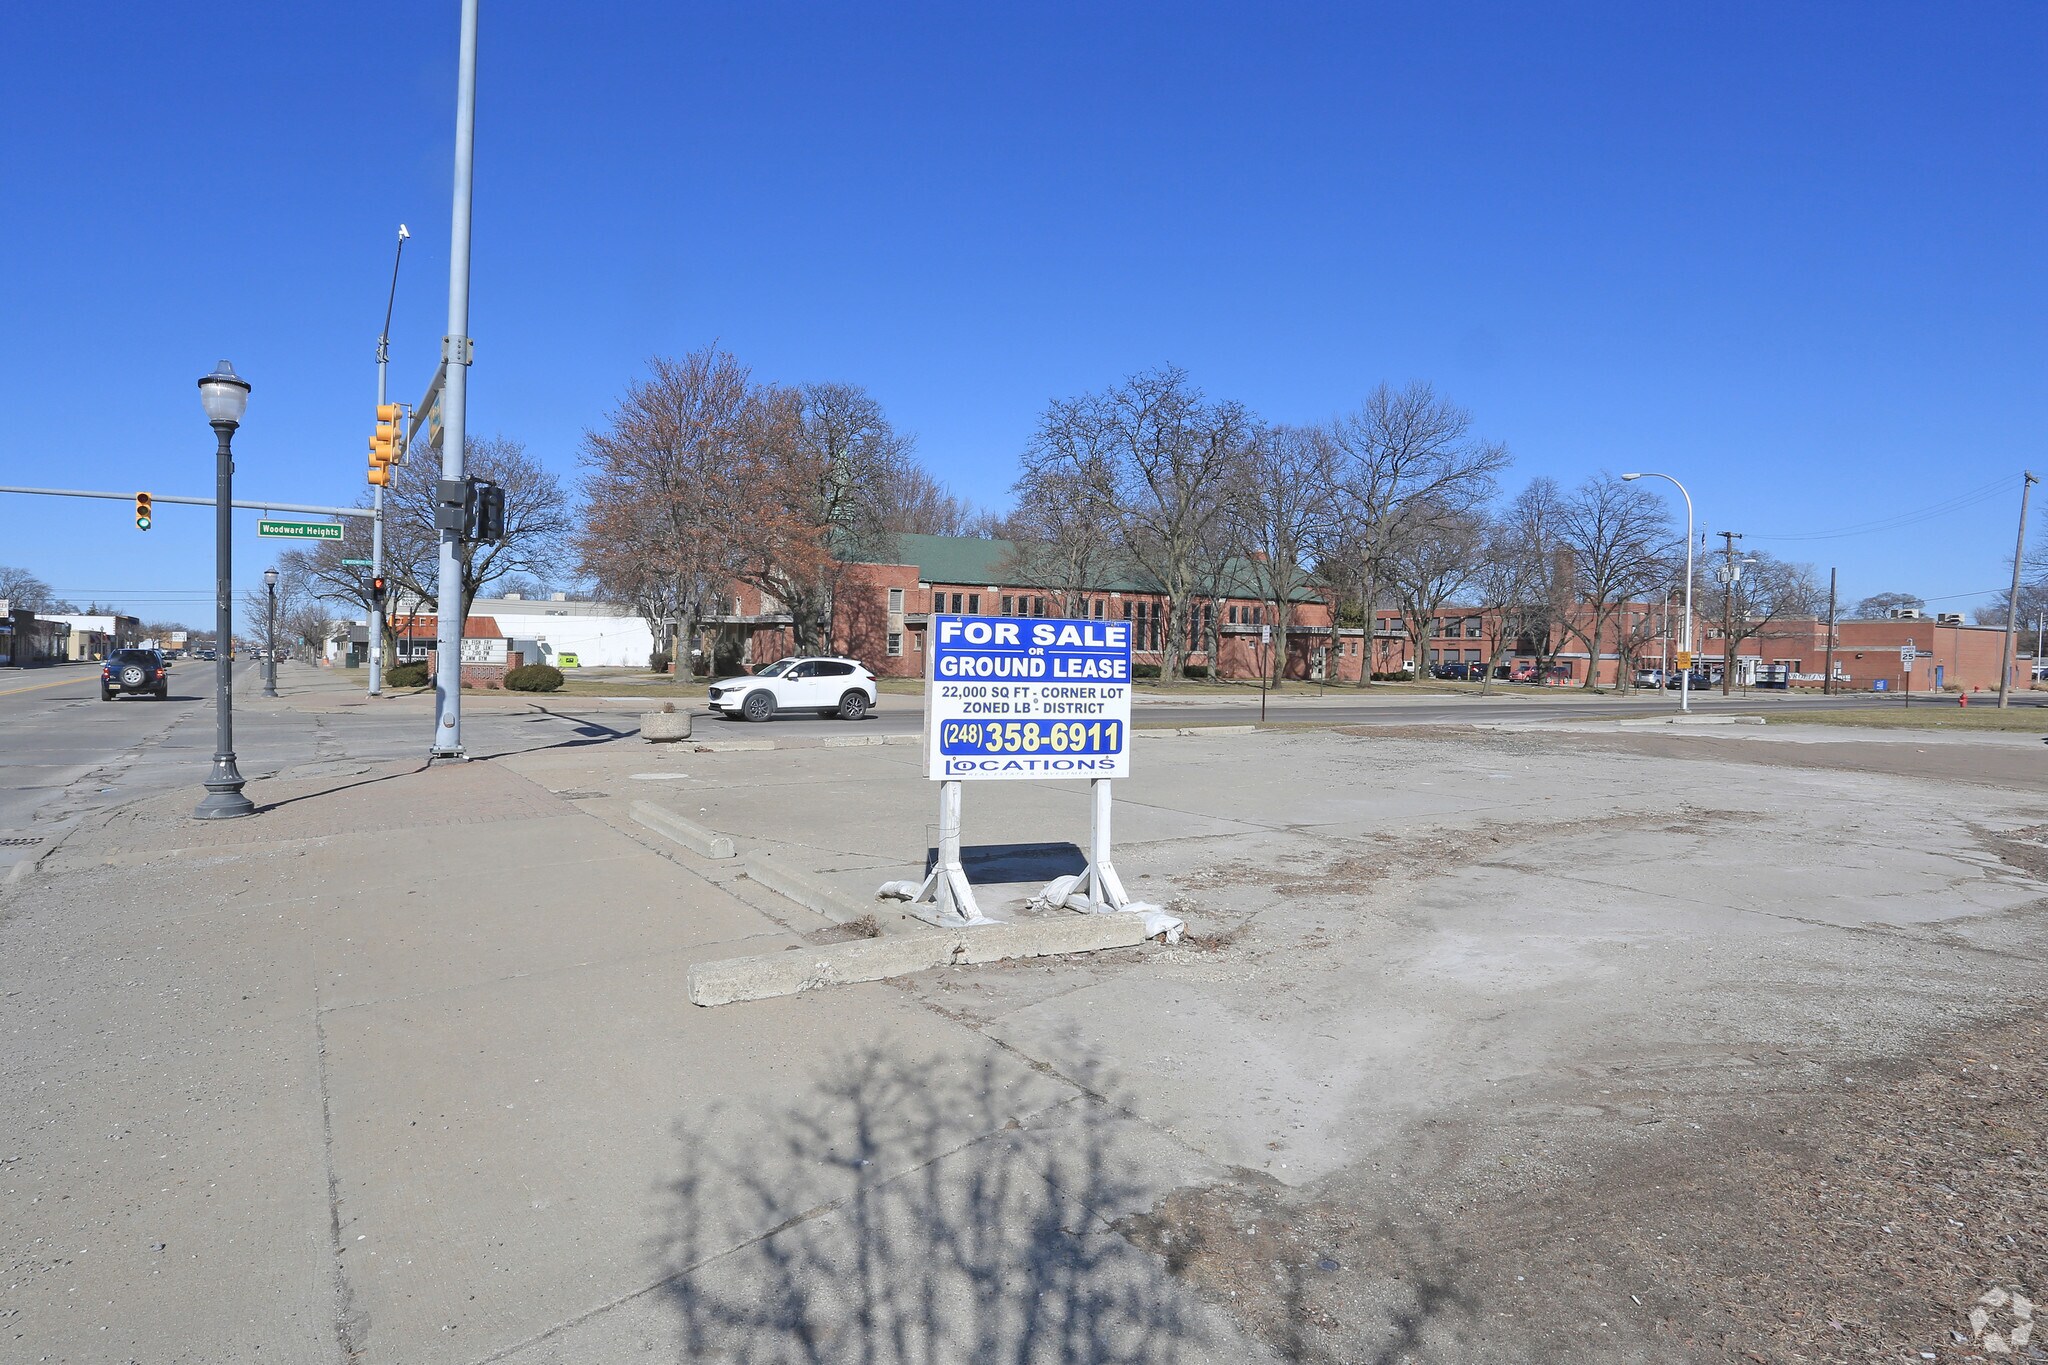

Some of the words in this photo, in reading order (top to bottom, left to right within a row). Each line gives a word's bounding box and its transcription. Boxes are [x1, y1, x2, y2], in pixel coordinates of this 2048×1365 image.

[262, 524, 304, 535] Woodward
[306, 526, 339, 538] Heights
[940, 621, 1021, 645] FOR
[1032, 624, 1127, 648] SALE
[1028, 647, 1044, 656] OR
[939, 655, 1046, 677] GROUND
[1053, 658, 1127, 679] LEASE
[941, 686, 987, 700] 22,000
[991, 686, 1009, 698] SQ
[1013, 686, 1030, 698] FT
[1041, 687, 1096, 699] CORNER
[1100, 688, 1124, 699] LOT
[962, 702, 1010, 713] ZONED
[1014, 702, 1031, 714] LB
[1043, 702, 1105, 714] DISTRICT
[943, 723, 983, 749] (248)
[985, 722, 1118, 752] 358-6911
[945, 759, 1116, 776] LOCATIONS
